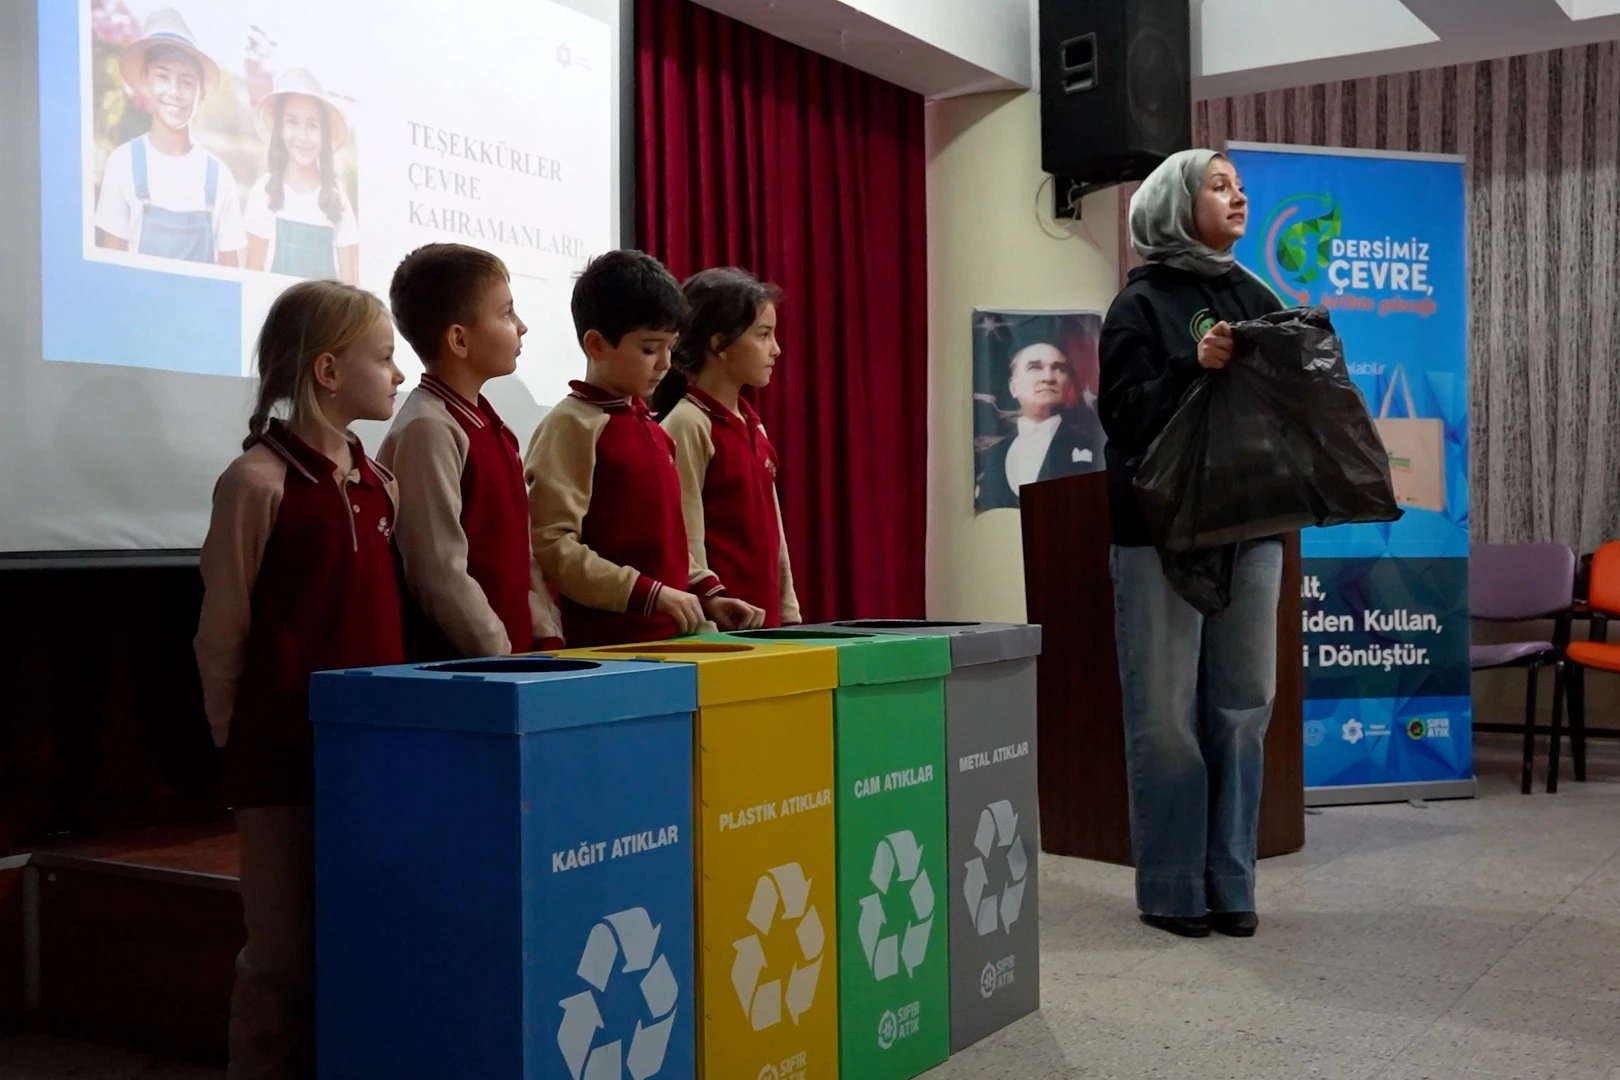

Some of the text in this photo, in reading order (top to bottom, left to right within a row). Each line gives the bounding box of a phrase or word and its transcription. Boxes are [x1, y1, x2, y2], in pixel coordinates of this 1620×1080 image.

[407, 121, 562, 182] TEŞEKKÜRLER
[408, 162, 481, 200] ÇEVRE
[408, 200, 585, 260] KAHRAMANLARI!
[1331, 236, 1430, 261] DERSİMİZ
[1328, 259, 1434, 296] ÇEVRE,
[1301, 575, 1327, 601] lt,
[1302, 609, 1443, 634] iden Kullan,
[1319, 643, 1430, 672] Dönüştür.
[959, 741, 1028, 772] METAL ATIKLAR
[854, 765, 933, 799] CAM ATIKLAR
[719, 789, 831, 832] PLASTİK ATIKLAR
[552, 825, 678, 873] KAĞIT ATIKLAR
[996, 954, 1015, 974] SIFIR
[997, 970, 1015, 988] ATIK
[897, 1001, 920, 1022] SIFIR
[899, 1018, 920, 1039] ATIK
